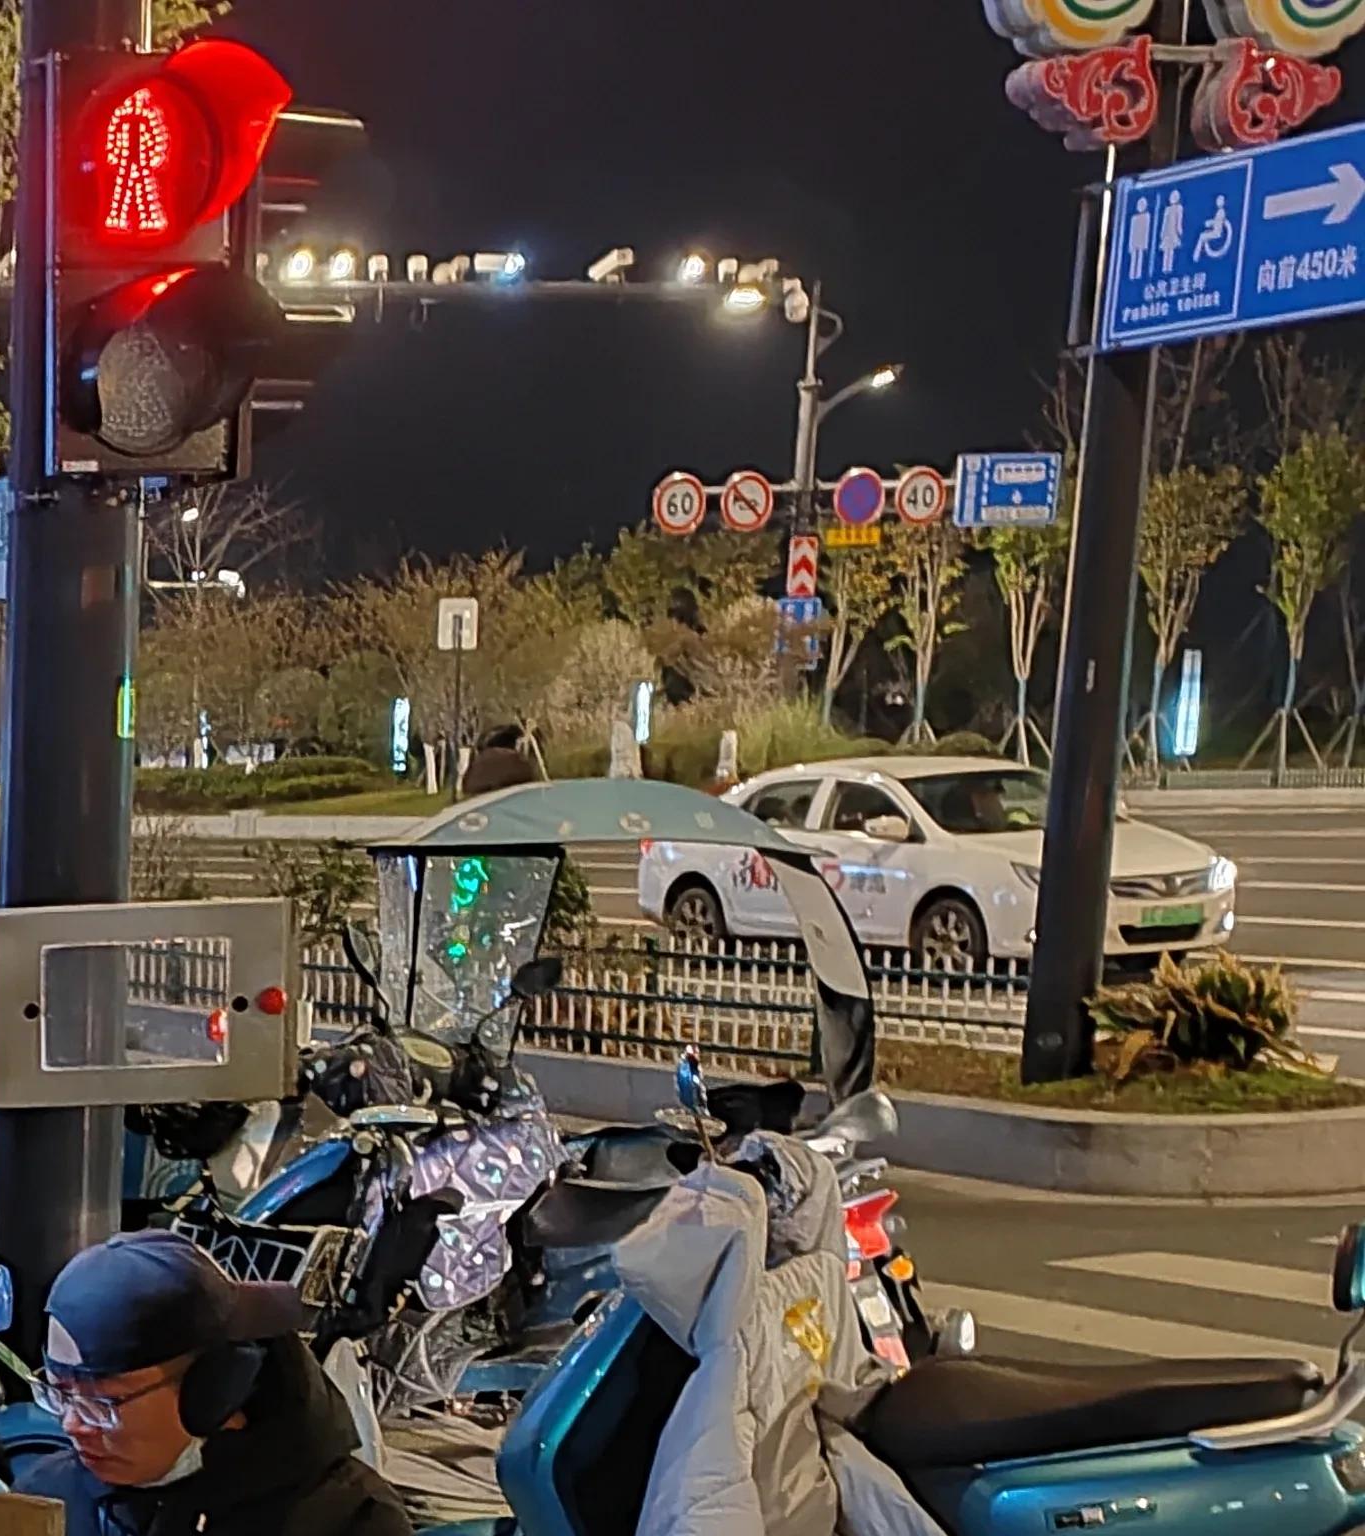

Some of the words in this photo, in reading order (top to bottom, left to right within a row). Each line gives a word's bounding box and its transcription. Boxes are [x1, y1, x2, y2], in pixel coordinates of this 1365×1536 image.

[1257, 245, 1358, 293] 向前450米
[1143, 272, 1207, 301] 公共卫生间
[667, 492, 694, 517] 60
[906, 485, 935, 508] 40
